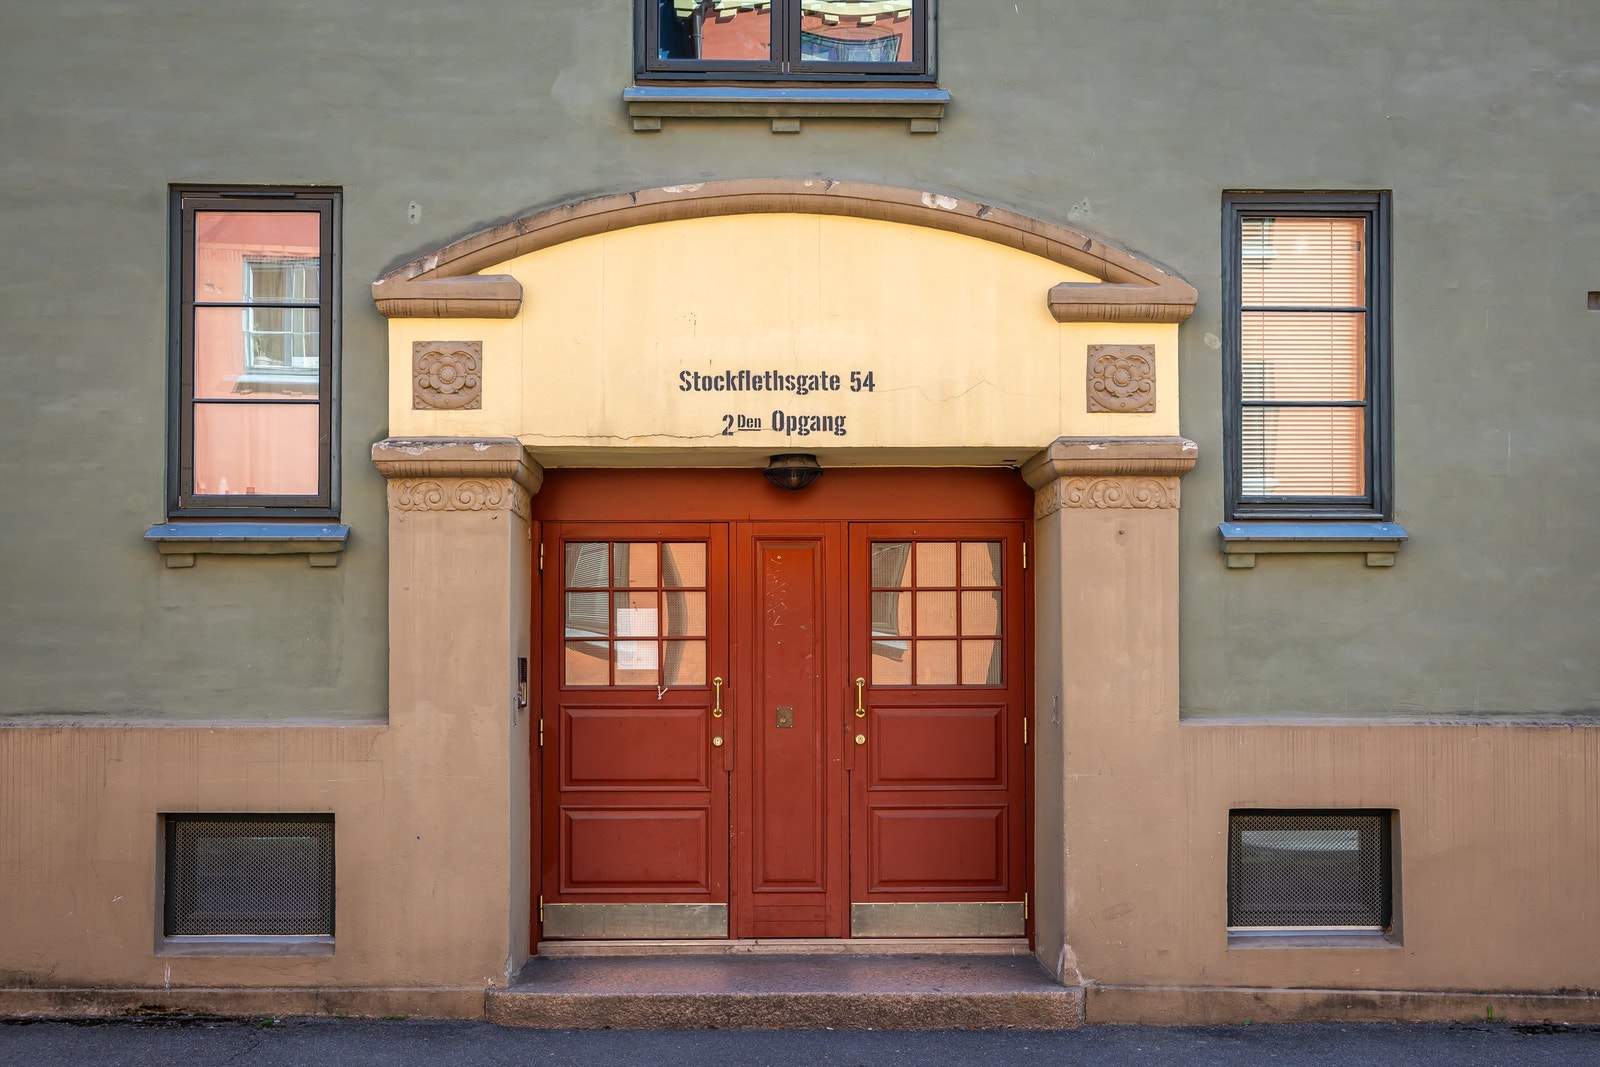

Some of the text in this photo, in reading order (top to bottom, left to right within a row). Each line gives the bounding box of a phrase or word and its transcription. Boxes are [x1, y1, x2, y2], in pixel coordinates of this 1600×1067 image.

[679, 370, 875, 395] Stockflethsgate 54
[771, 410, 847, 436] Opgang
